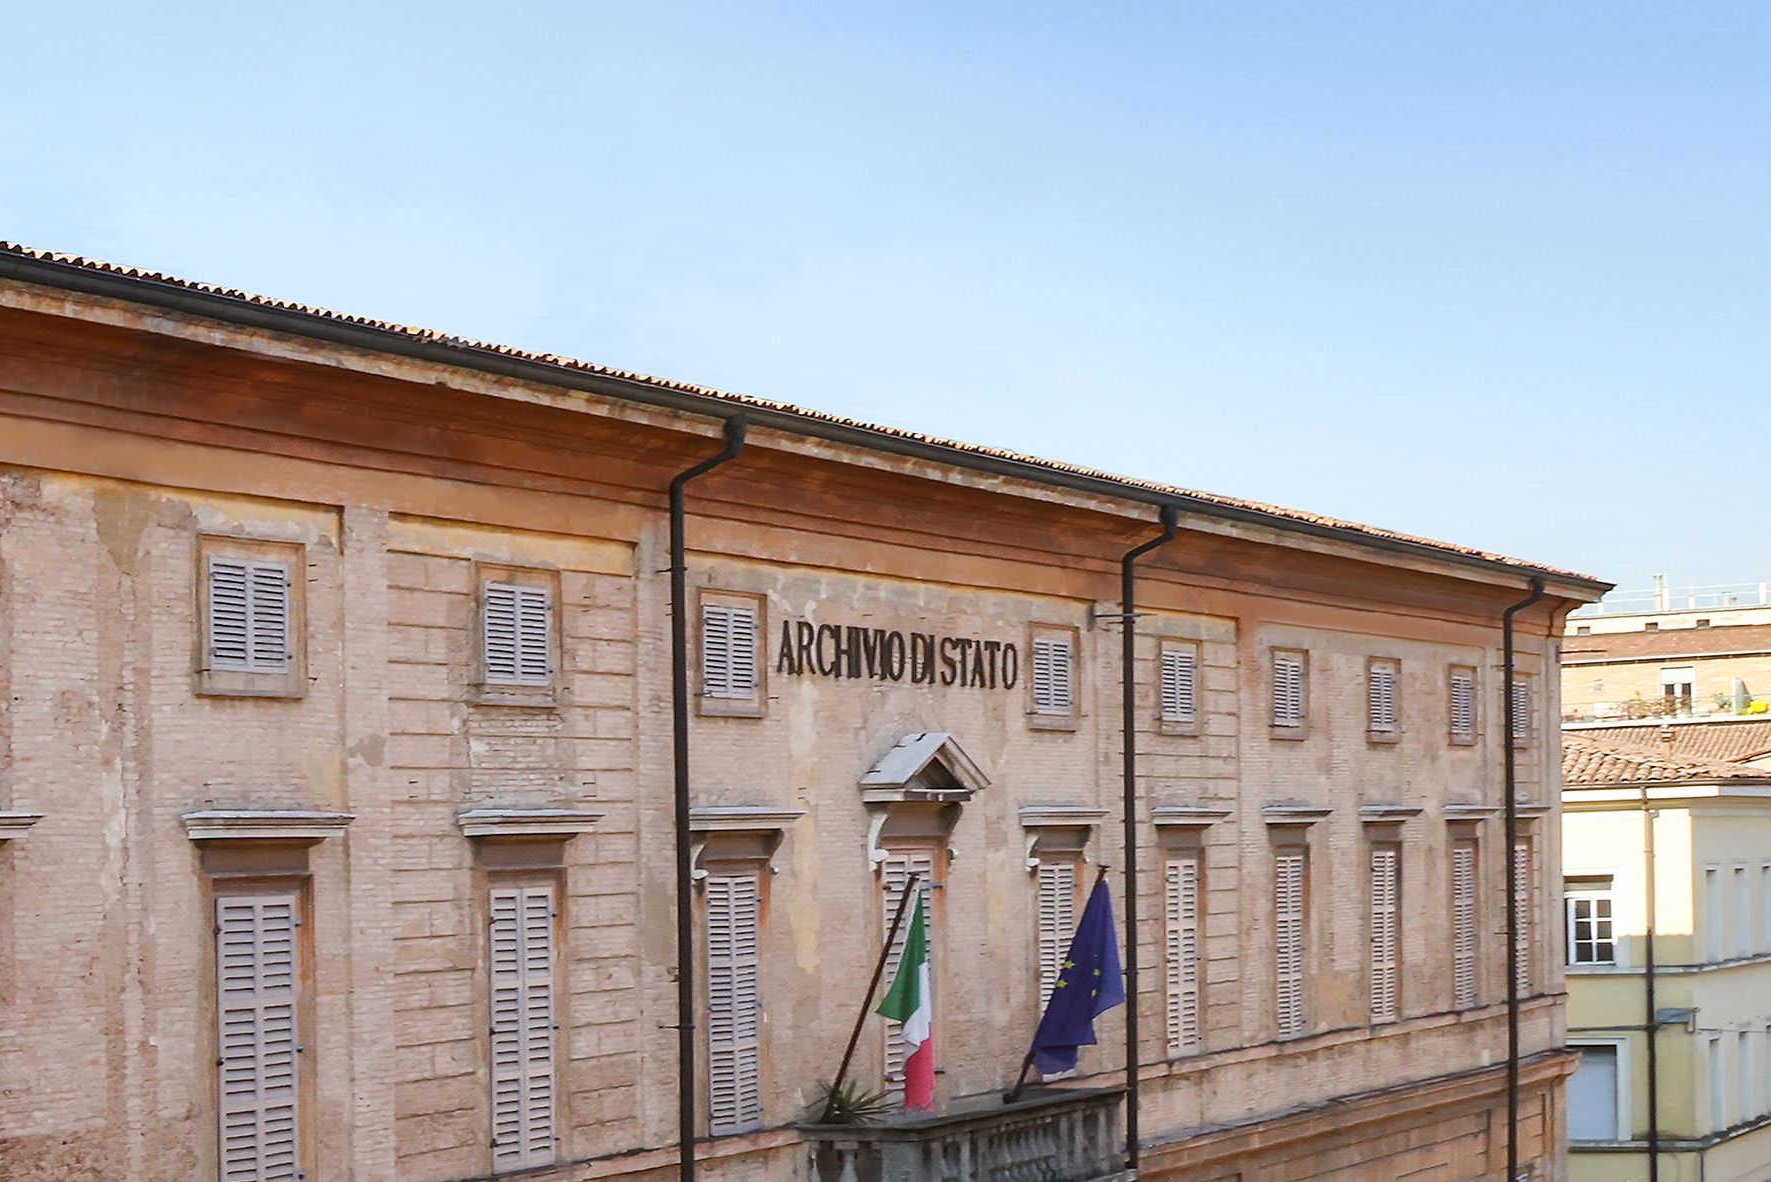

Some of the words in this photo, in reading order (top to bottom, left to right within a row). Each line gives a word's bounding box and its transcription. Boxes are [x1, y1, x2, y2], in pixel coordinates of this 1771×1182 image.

[778, 620, 906, 681] ARCHIVIO
[910, 632, 936, 684] DI
[940, 637, 1018, 690] STATO
